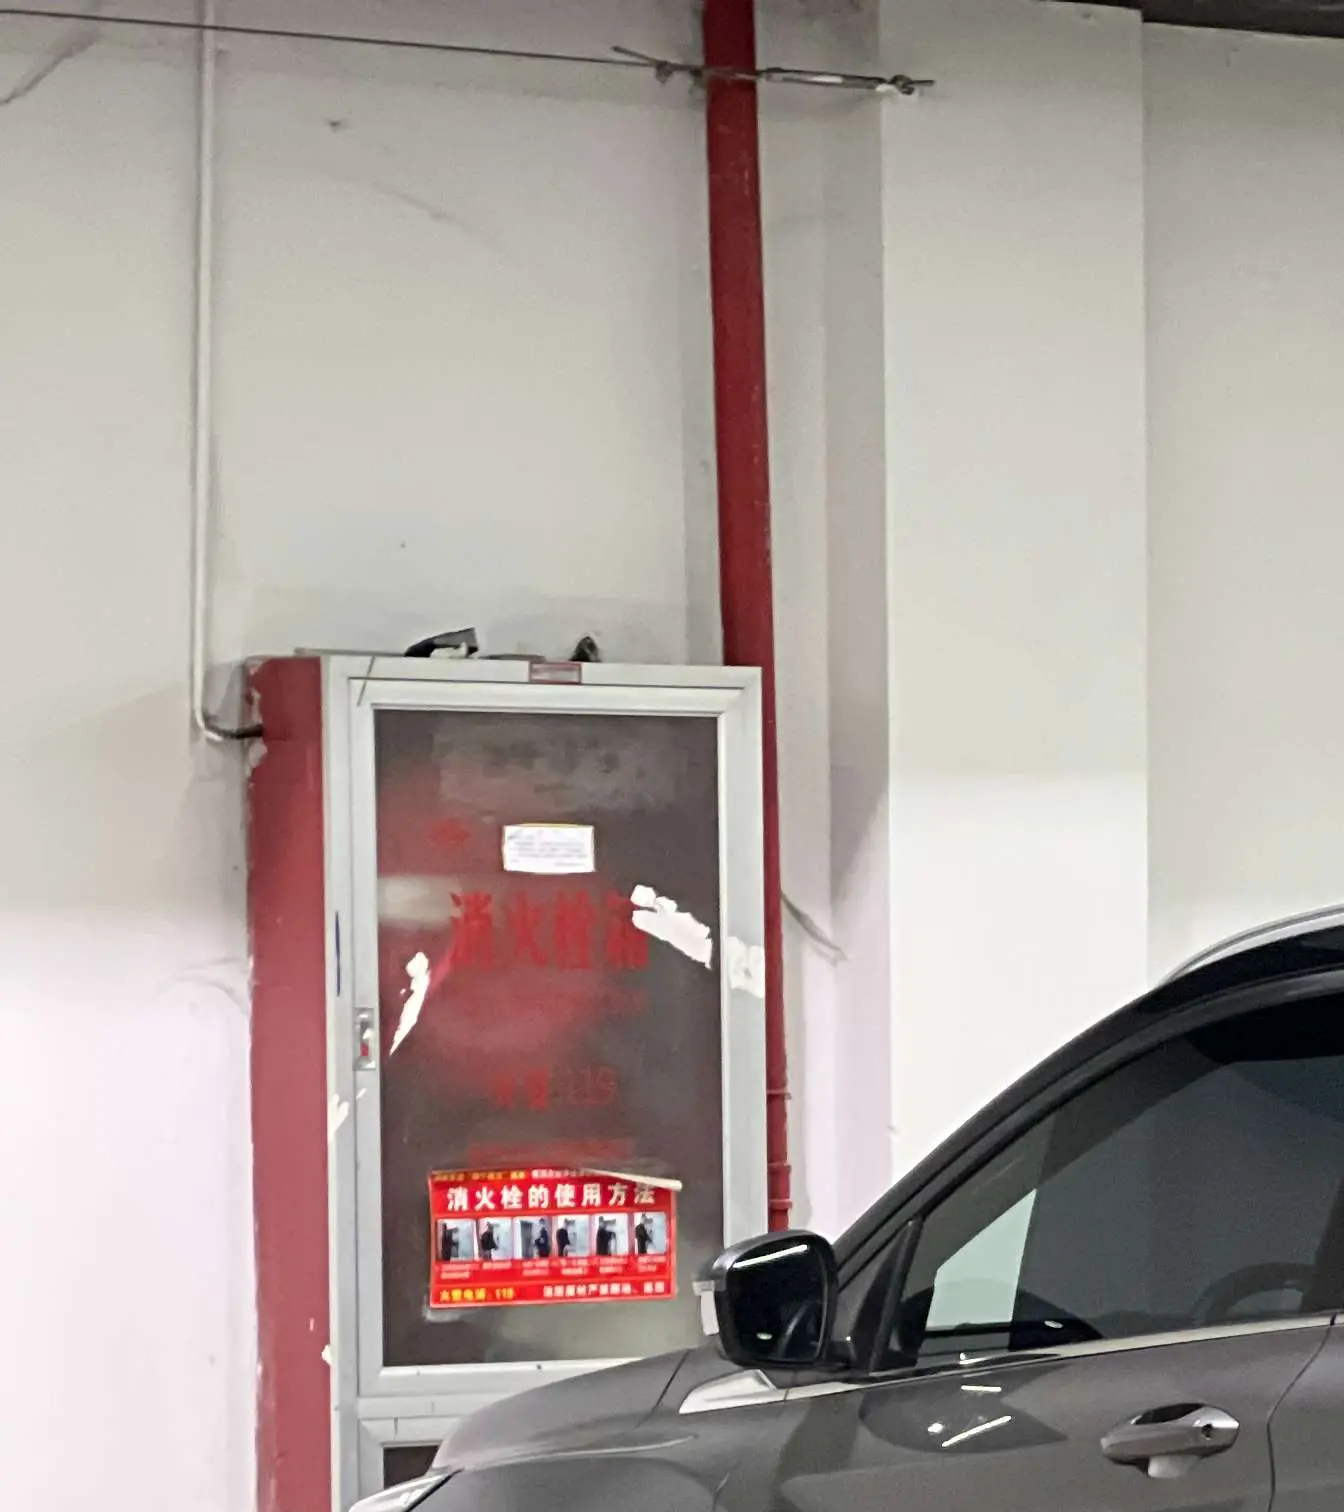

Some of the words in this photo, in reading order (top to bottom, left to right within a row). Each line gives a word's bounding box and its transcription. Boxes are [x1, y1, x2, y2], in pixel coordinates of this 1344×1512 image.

[446, 1181, 656, 1212] 消火栓的使用方法
